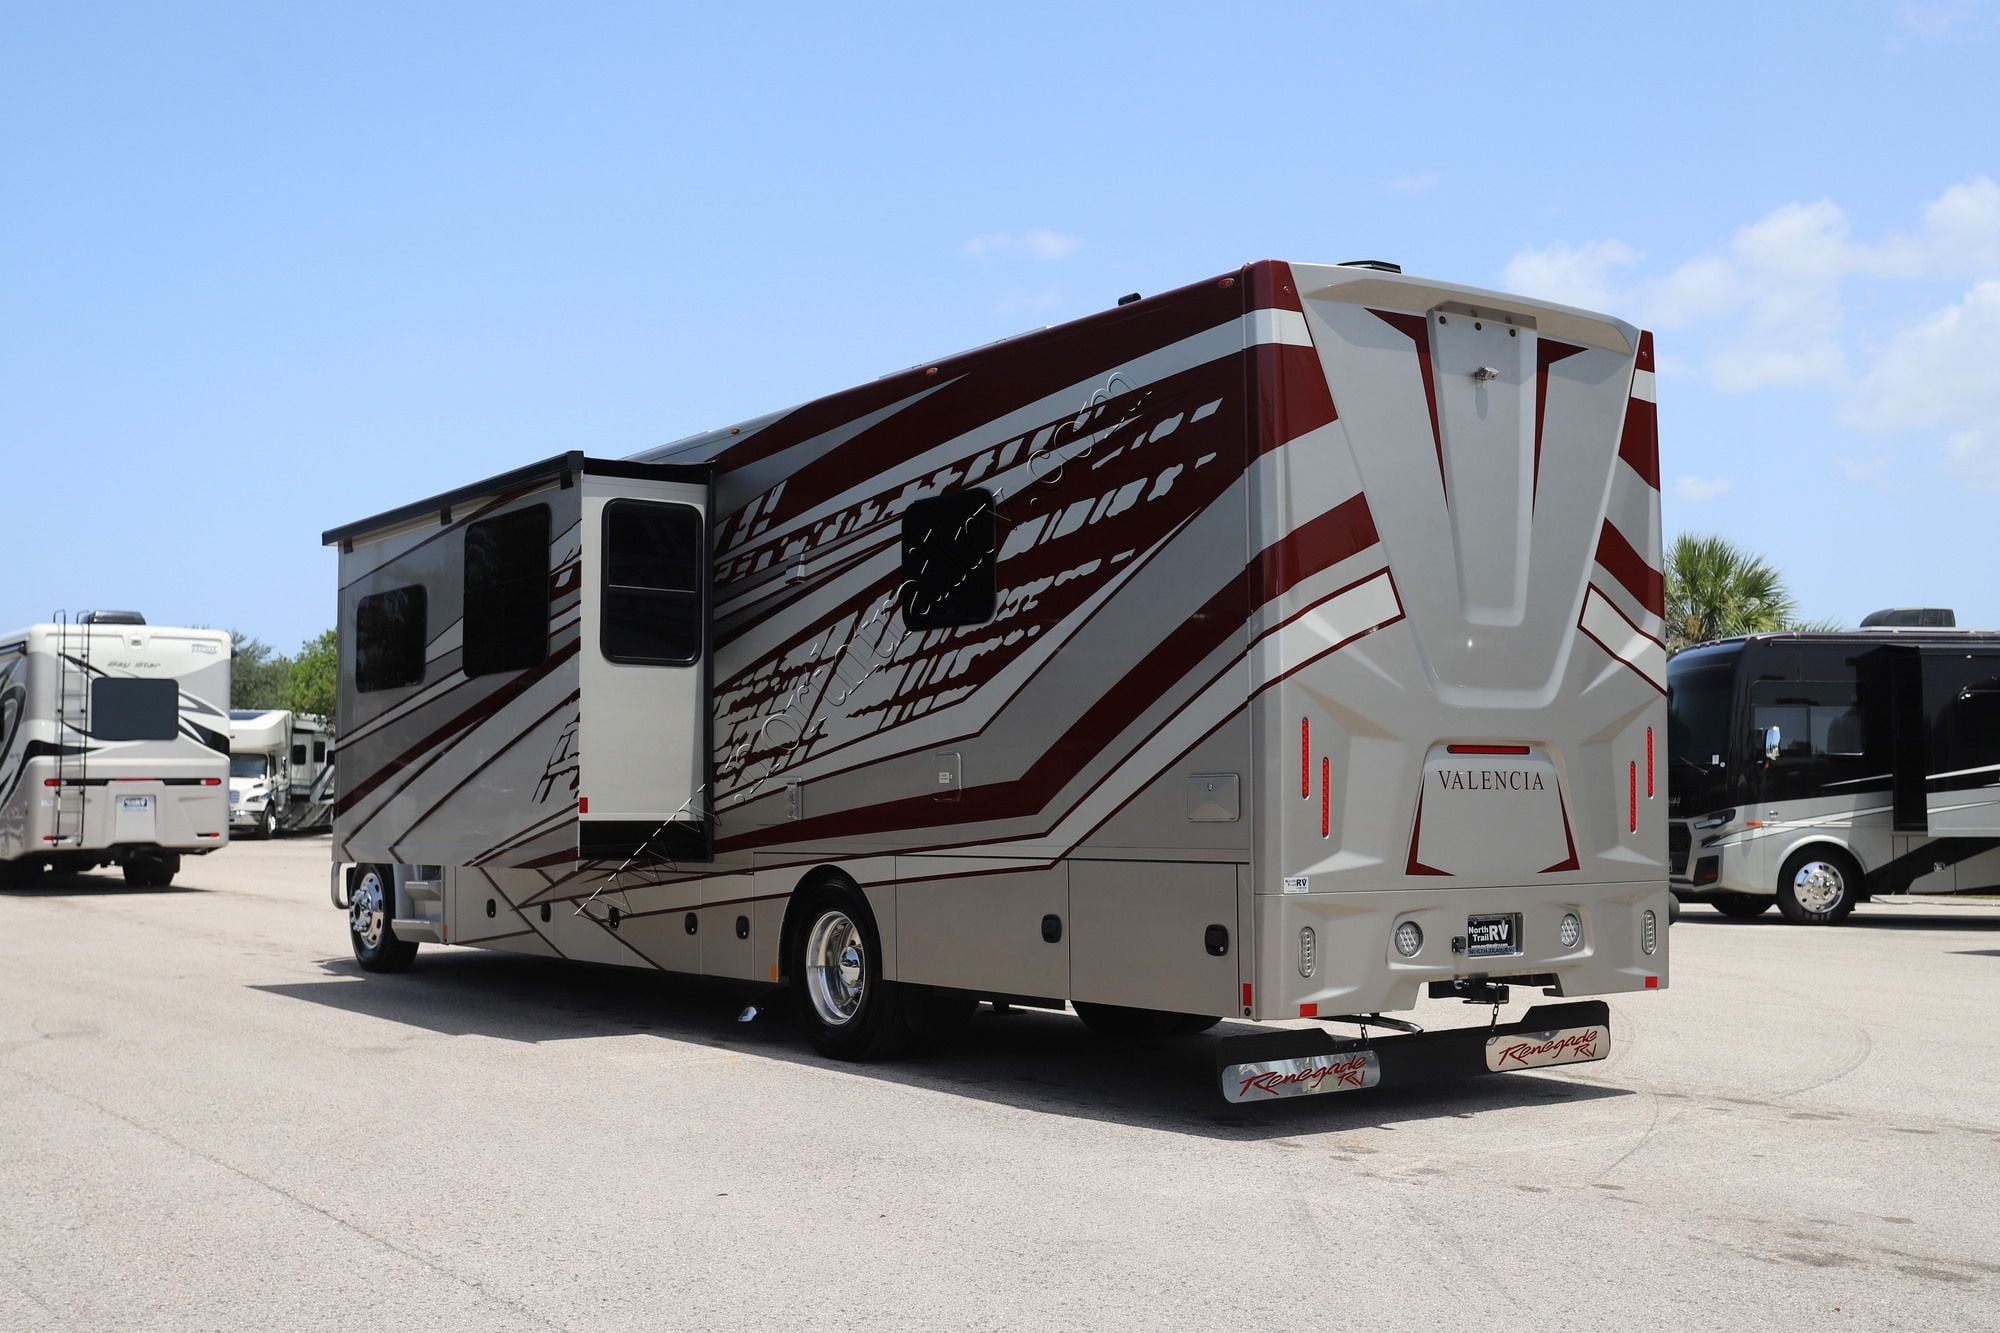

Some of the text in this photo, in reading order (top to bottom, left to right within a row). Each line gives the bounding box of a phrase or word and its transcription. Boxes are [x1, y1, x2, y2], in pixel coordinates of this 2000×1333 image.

[1438, 769, 1545, 791] VALENCIA
[1296, 878, 1307, 887] RV
[1468, 925, 1489, 934] North
[1472, 933, 1489, 942] Trail
[1488, 923, 1509, 941] RV
[1498, 1028, 1598, 1066] Renegade
[1573, 1043, 1597, 1058] RV
[1239, 1055, 1366, 1097] Renegade
[1337, 1070, 1366, 1087] RV
